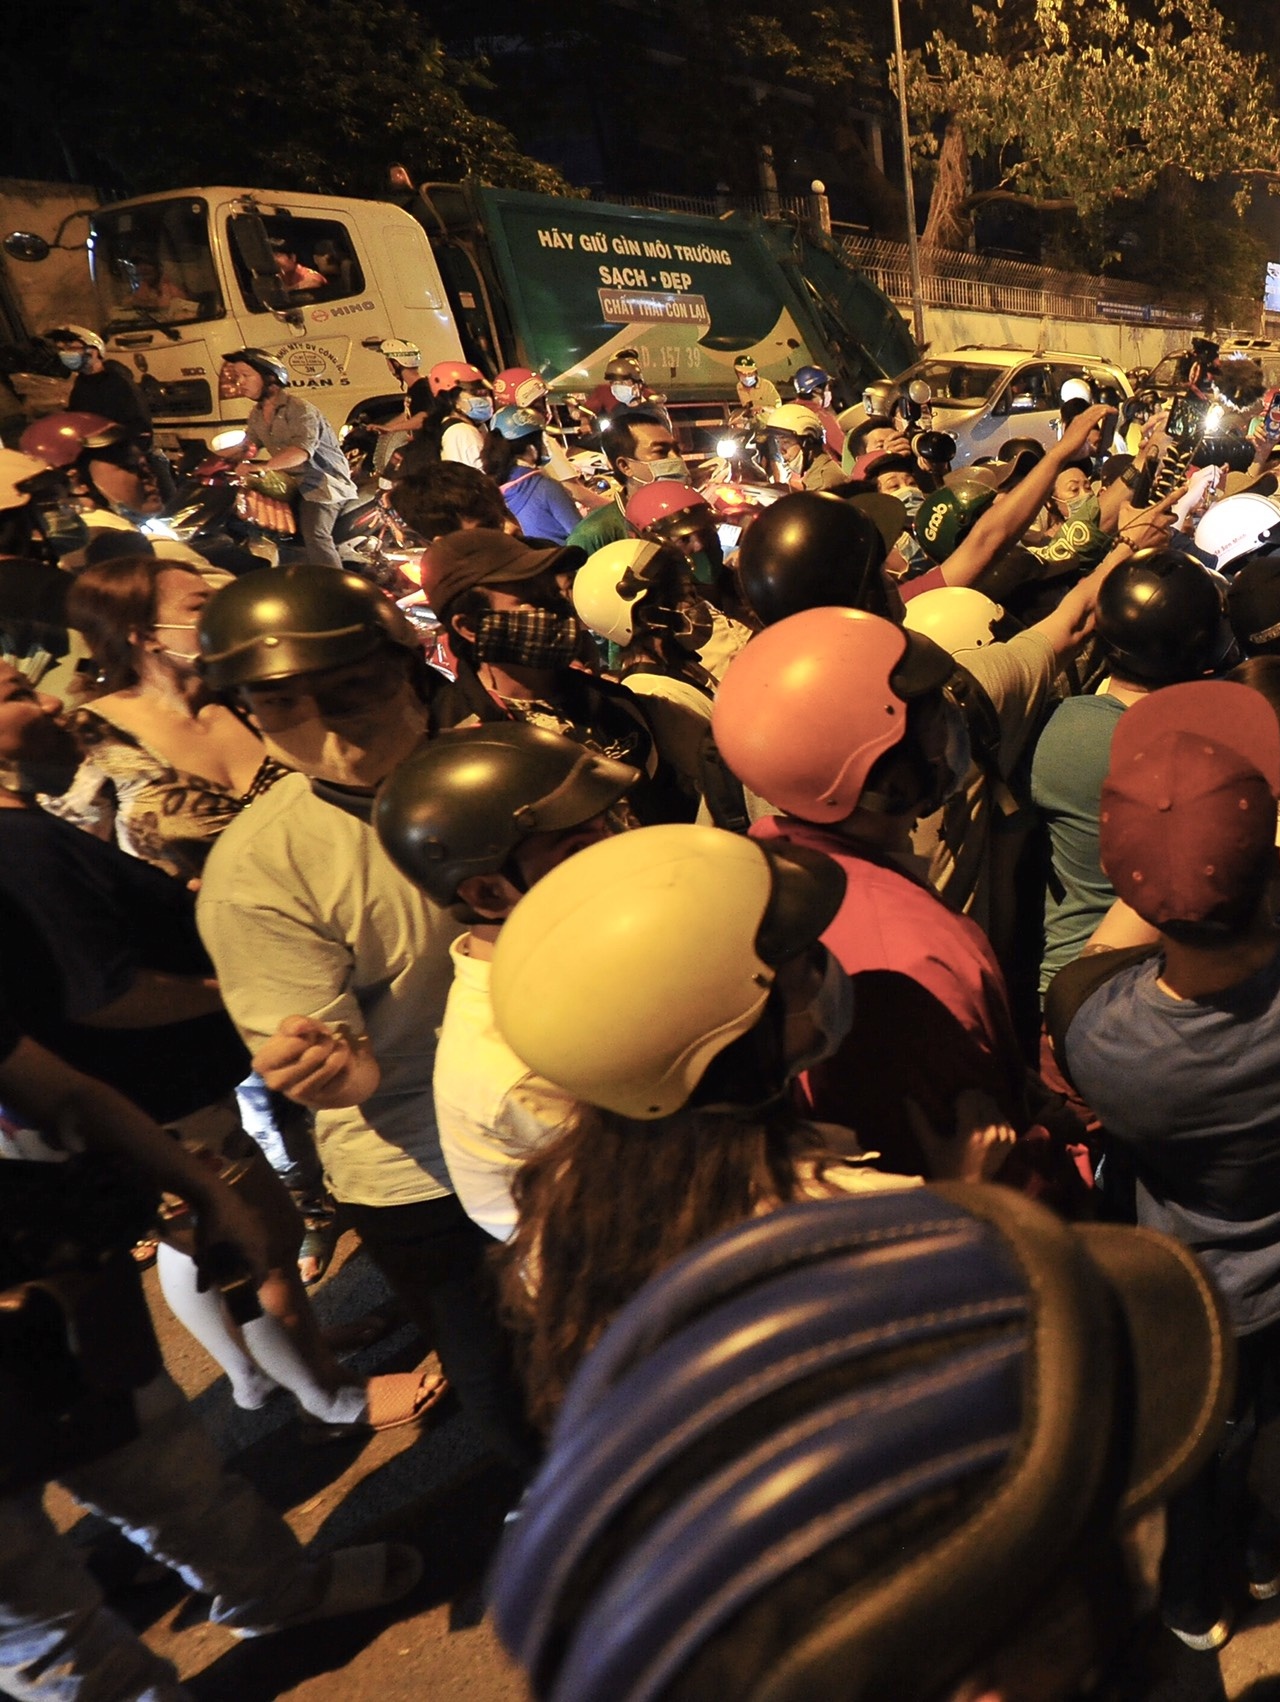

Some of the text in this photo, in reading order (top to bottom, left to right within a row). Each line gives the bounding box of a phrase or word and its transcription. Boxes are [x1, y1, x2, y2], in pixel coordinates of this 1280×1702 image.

[538, 228, 732, 265] HÃY GIỮ GÌN MÔI TRƯỜNG
[599, 265, 649, 290] SẠCH
[659, 271, 692, 294] ĐẸP
[330, 301, 375, 317] HINO
[689, 303, 706, 322] LẠI
[660, 346, 680, 367] 157
[686, 347, 700, 368] 39
[340, 378, 351, 386] 5
[925, 503, 947, 541] Grab
